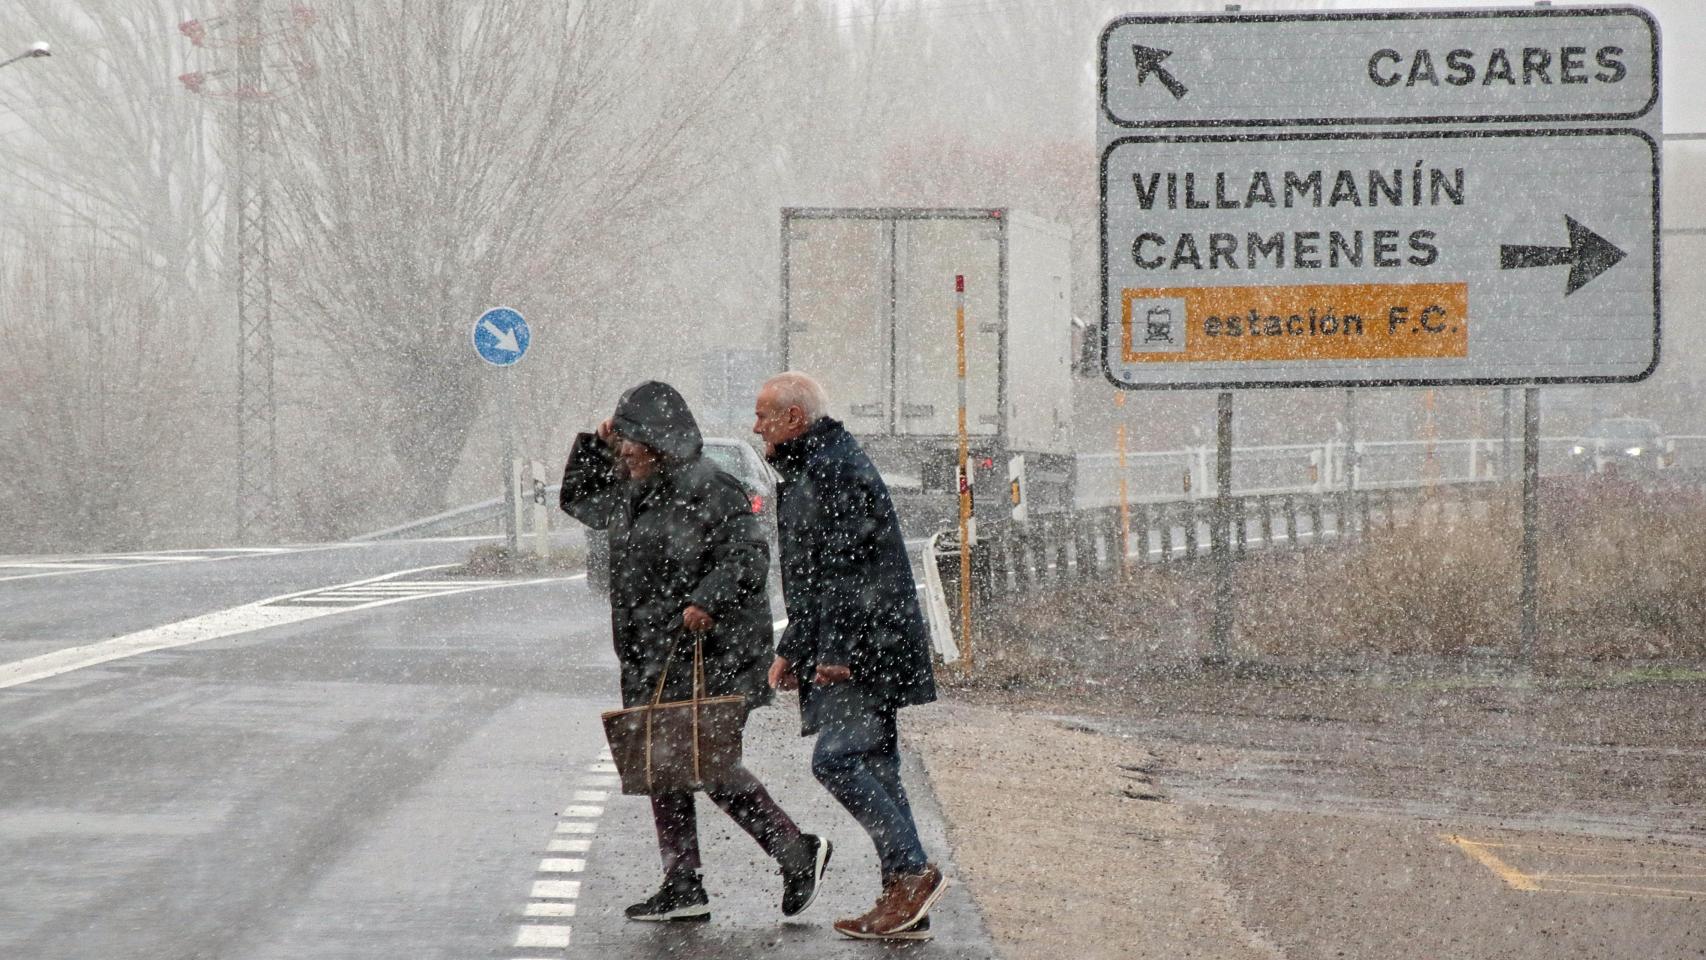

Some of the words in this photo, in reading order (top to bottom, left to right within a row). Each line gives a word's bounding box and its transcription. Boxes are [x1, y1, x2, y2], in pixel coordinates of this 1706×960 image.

[1367, 45, 1627, 88] CASARES
[1132, 160, 1466, 210] VILLAMANÍN
[1131, 229, 1440, 271] CARMENES
[1203, 307, 1364, 338] estación
[1388, 306, 1459, 336] F.C.
